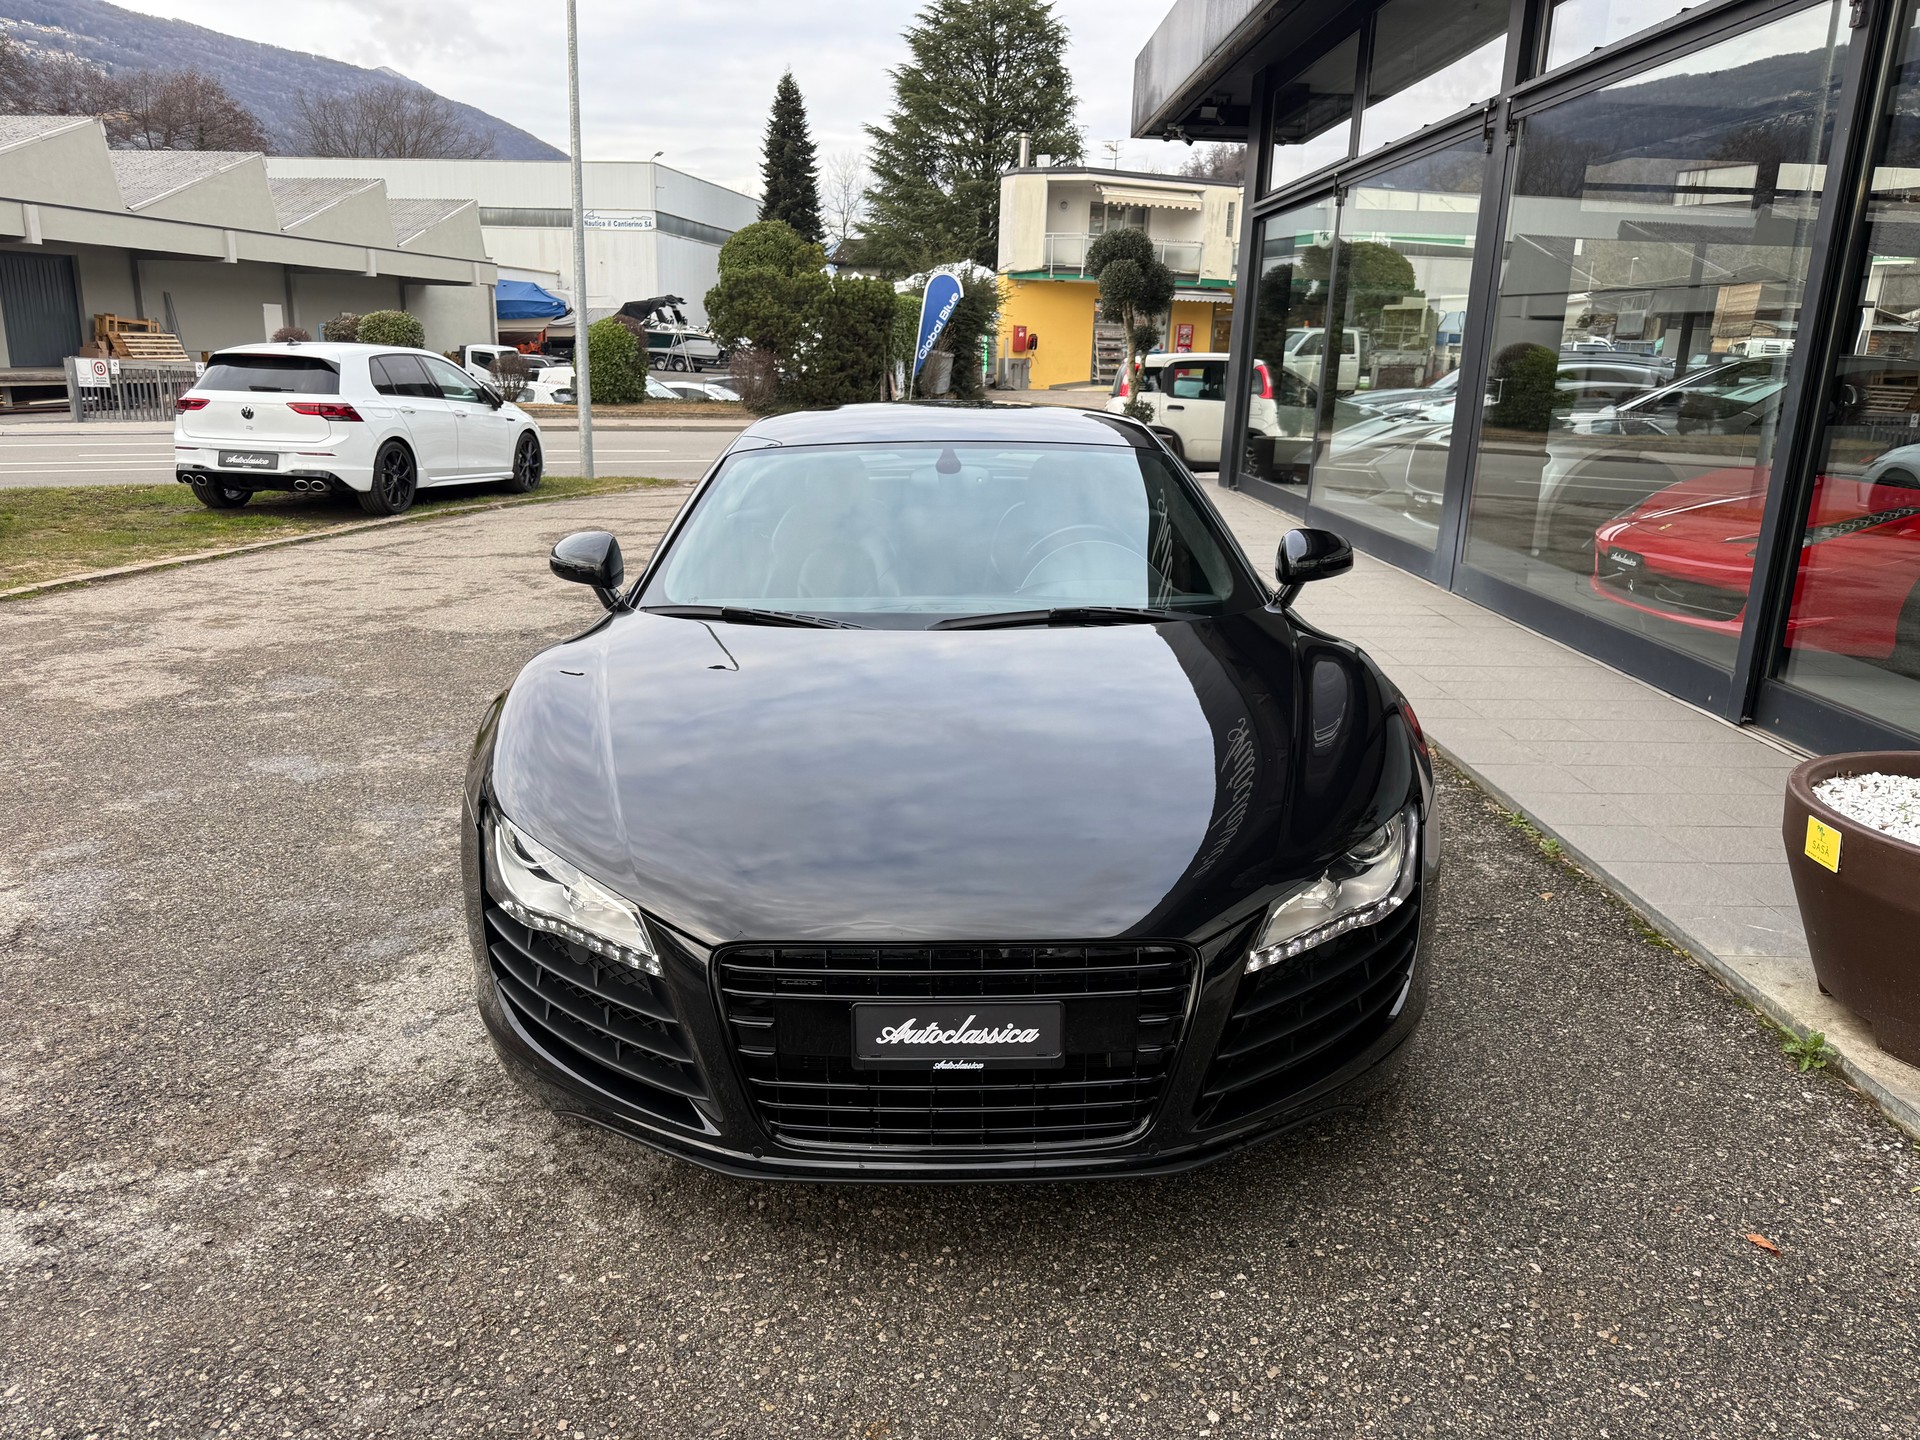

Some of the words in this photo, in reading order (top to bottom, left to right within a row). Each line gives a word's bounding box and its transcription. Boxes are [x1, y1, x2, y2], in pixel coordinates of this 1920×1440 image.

[918, 320, 943, 359] Global
[939, 292, 959, 320] Blue
[876, 1014, 1040, 1044] Autoclassica
[933, 1060, 984, 1069] Autoclassica
